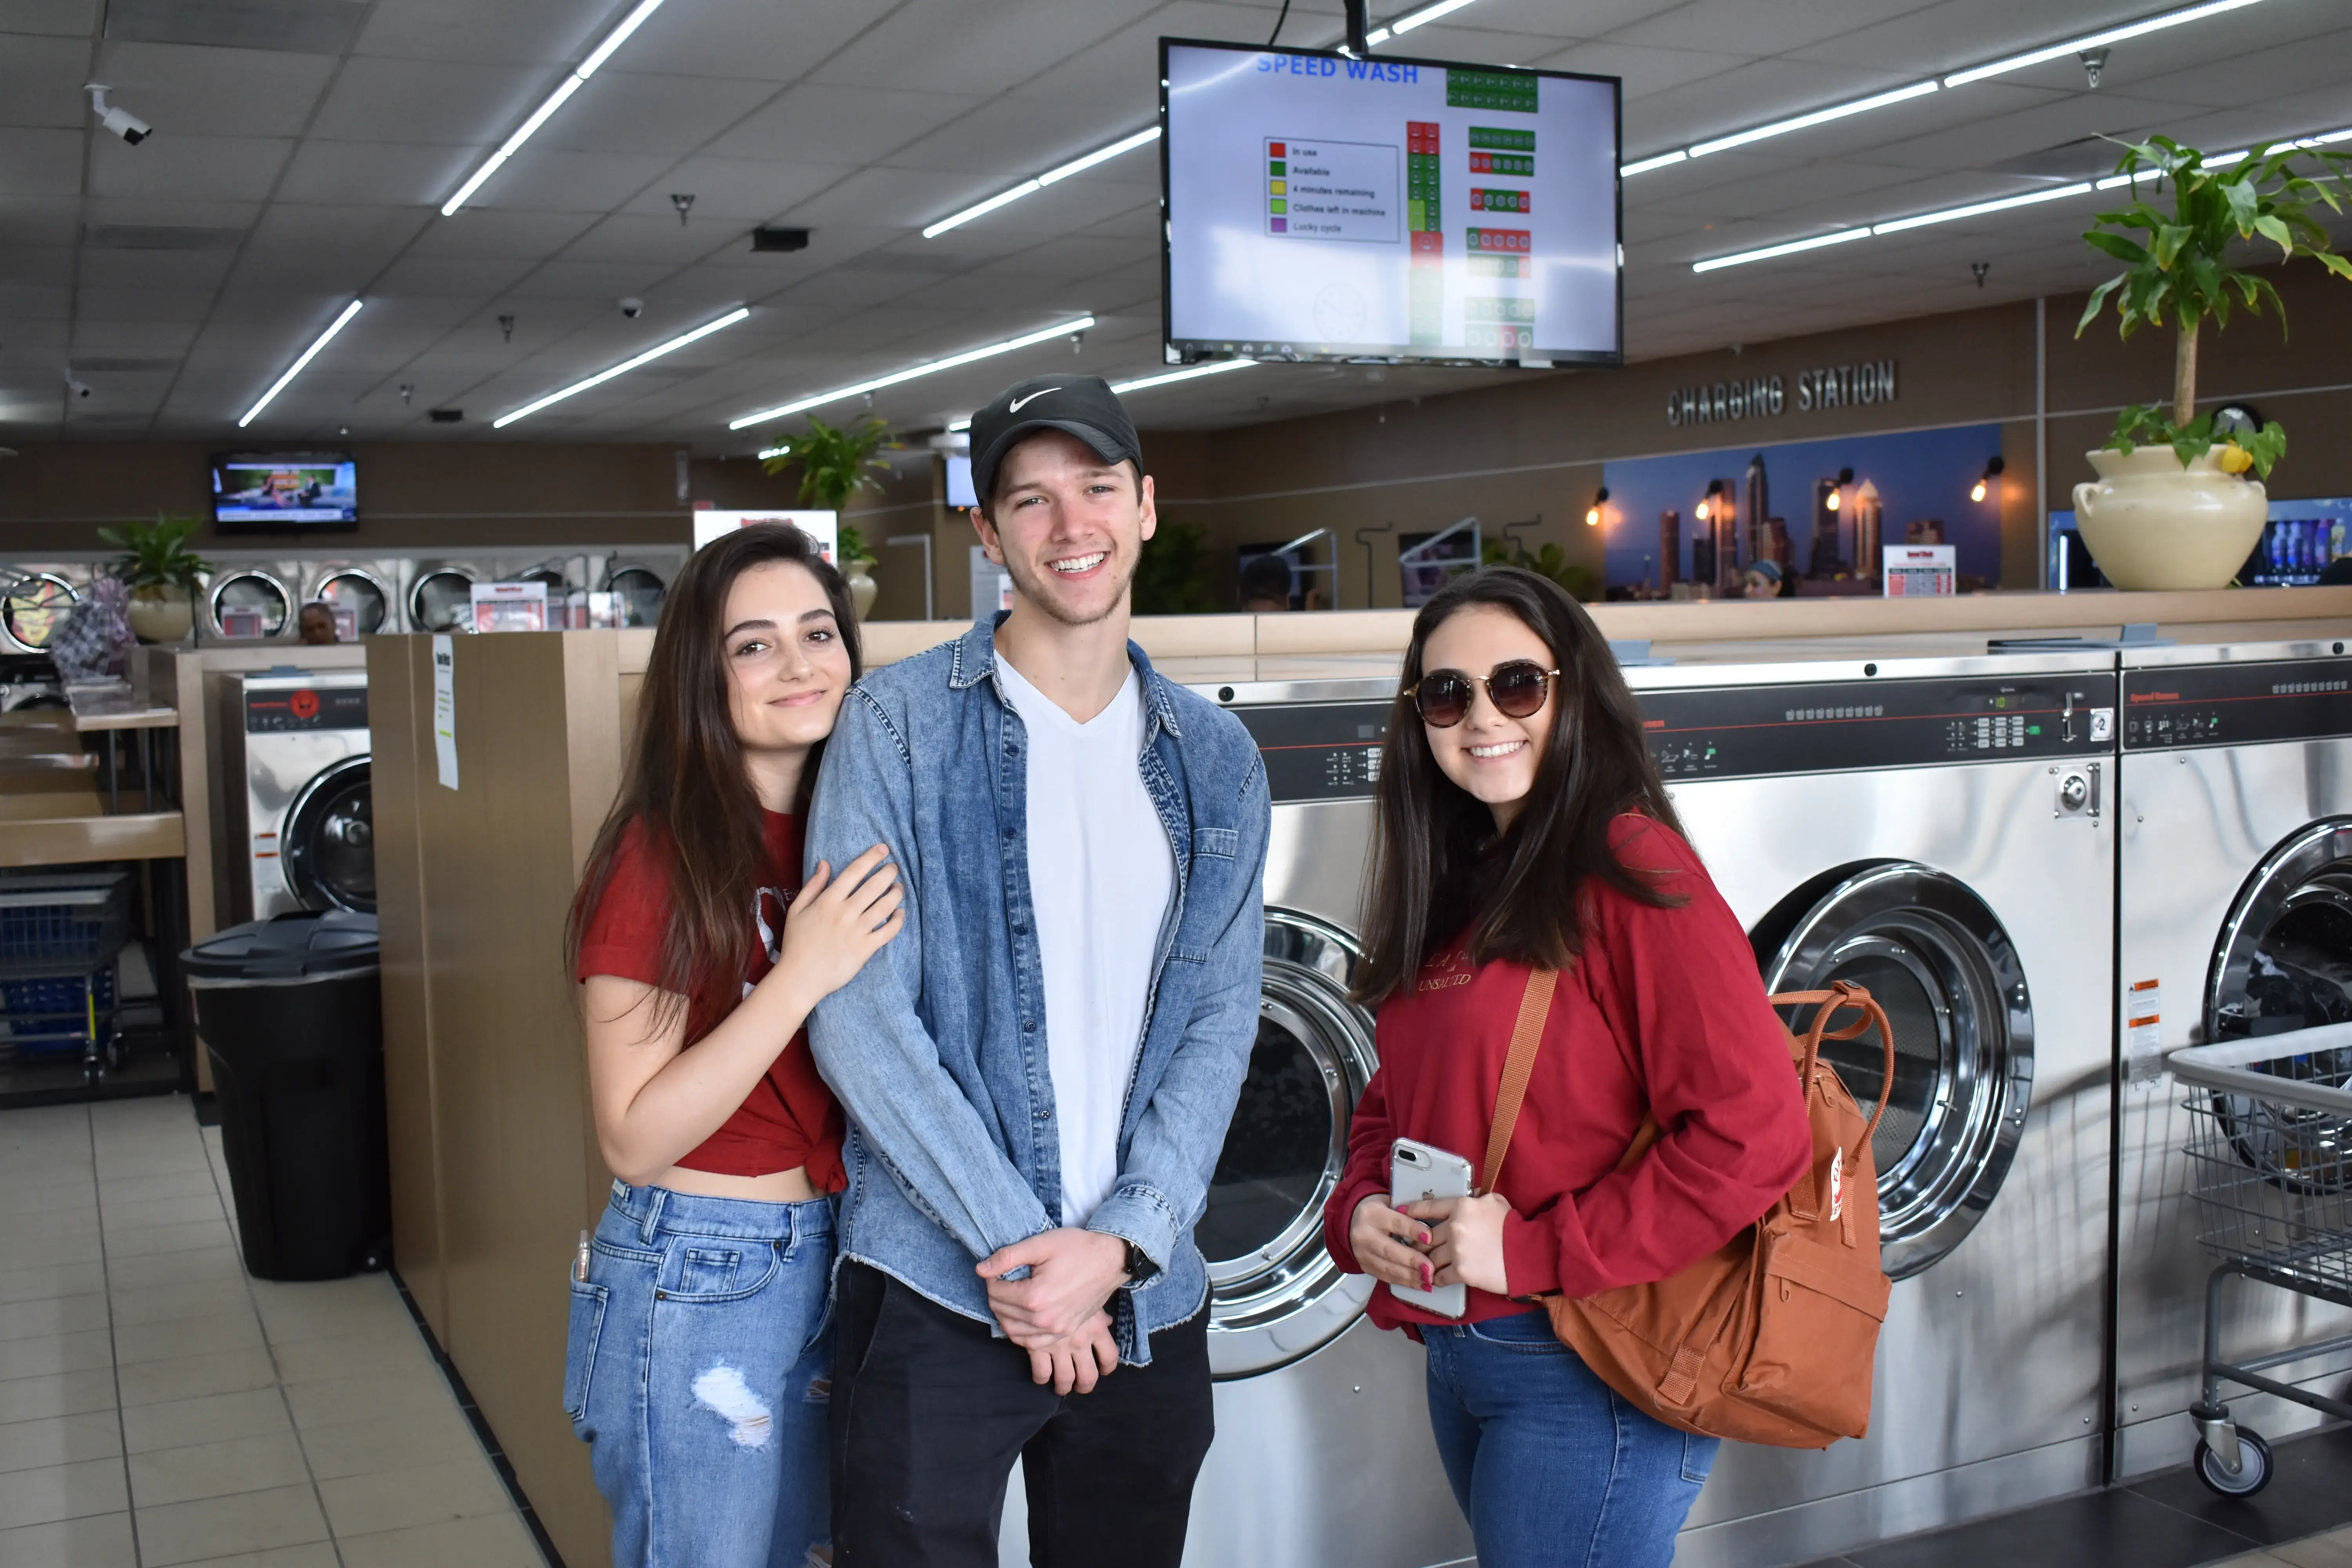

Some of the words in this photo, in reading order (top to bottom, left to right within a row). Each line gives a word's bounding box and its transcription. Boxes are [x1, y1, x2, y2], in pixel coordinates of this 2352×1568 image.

[1257, 54, 1336, 77] SPEED
[1347, 60, 1418, 84] WASH
[1293, 166, 1330, 176] Available
[1335, 189, 1375, 199] remaining
[1293, 204, 1324, 213] Clothes
[1326, 205, 1339, 214] left
[1351, 208, 1386, 216] machine
[1293, 223, 1318, 233] Lucky
[1320, 225, 1341, 233] cycle
[1667, 375, 1784, 426] CHARGING
[1798, 359, 1896, 412] STATION
[1419, 974, 1471, 991] UNSALTED
